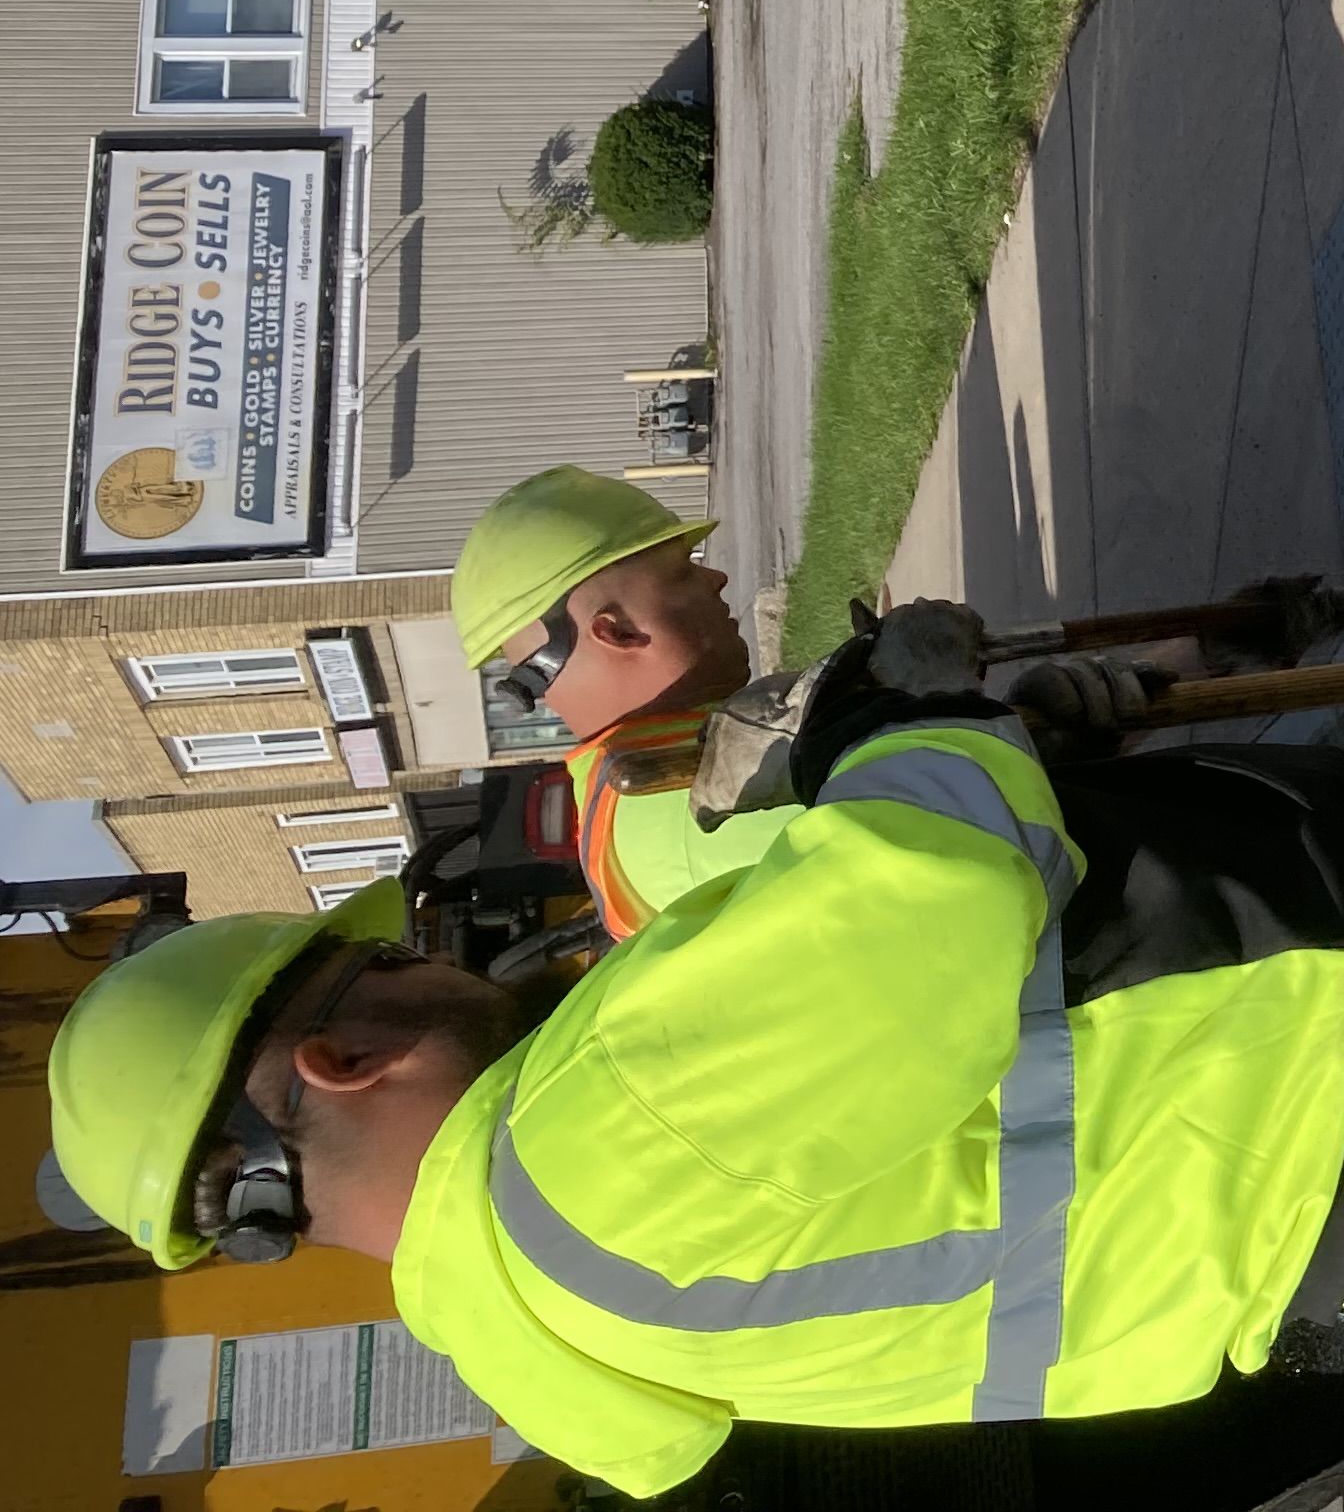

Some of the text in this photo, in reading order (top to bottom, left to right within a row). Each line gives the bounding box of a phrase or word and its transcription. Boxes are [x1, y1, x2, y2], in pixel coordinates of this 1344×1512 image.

[113, 167, 191, 417] RIDGE COIN
[186, 173, 231, 409] BUYS SELLS
[298, 173, 314, 281] ridgecoins@aol.com
[239, 183, 270, 513] COINS GOLD SILVER JEWELRY
[260, 243, 284, 447] STAMPS CURRENCY
[284, 301, 307, 519] APPRAISALS & CONSULTATIONS
